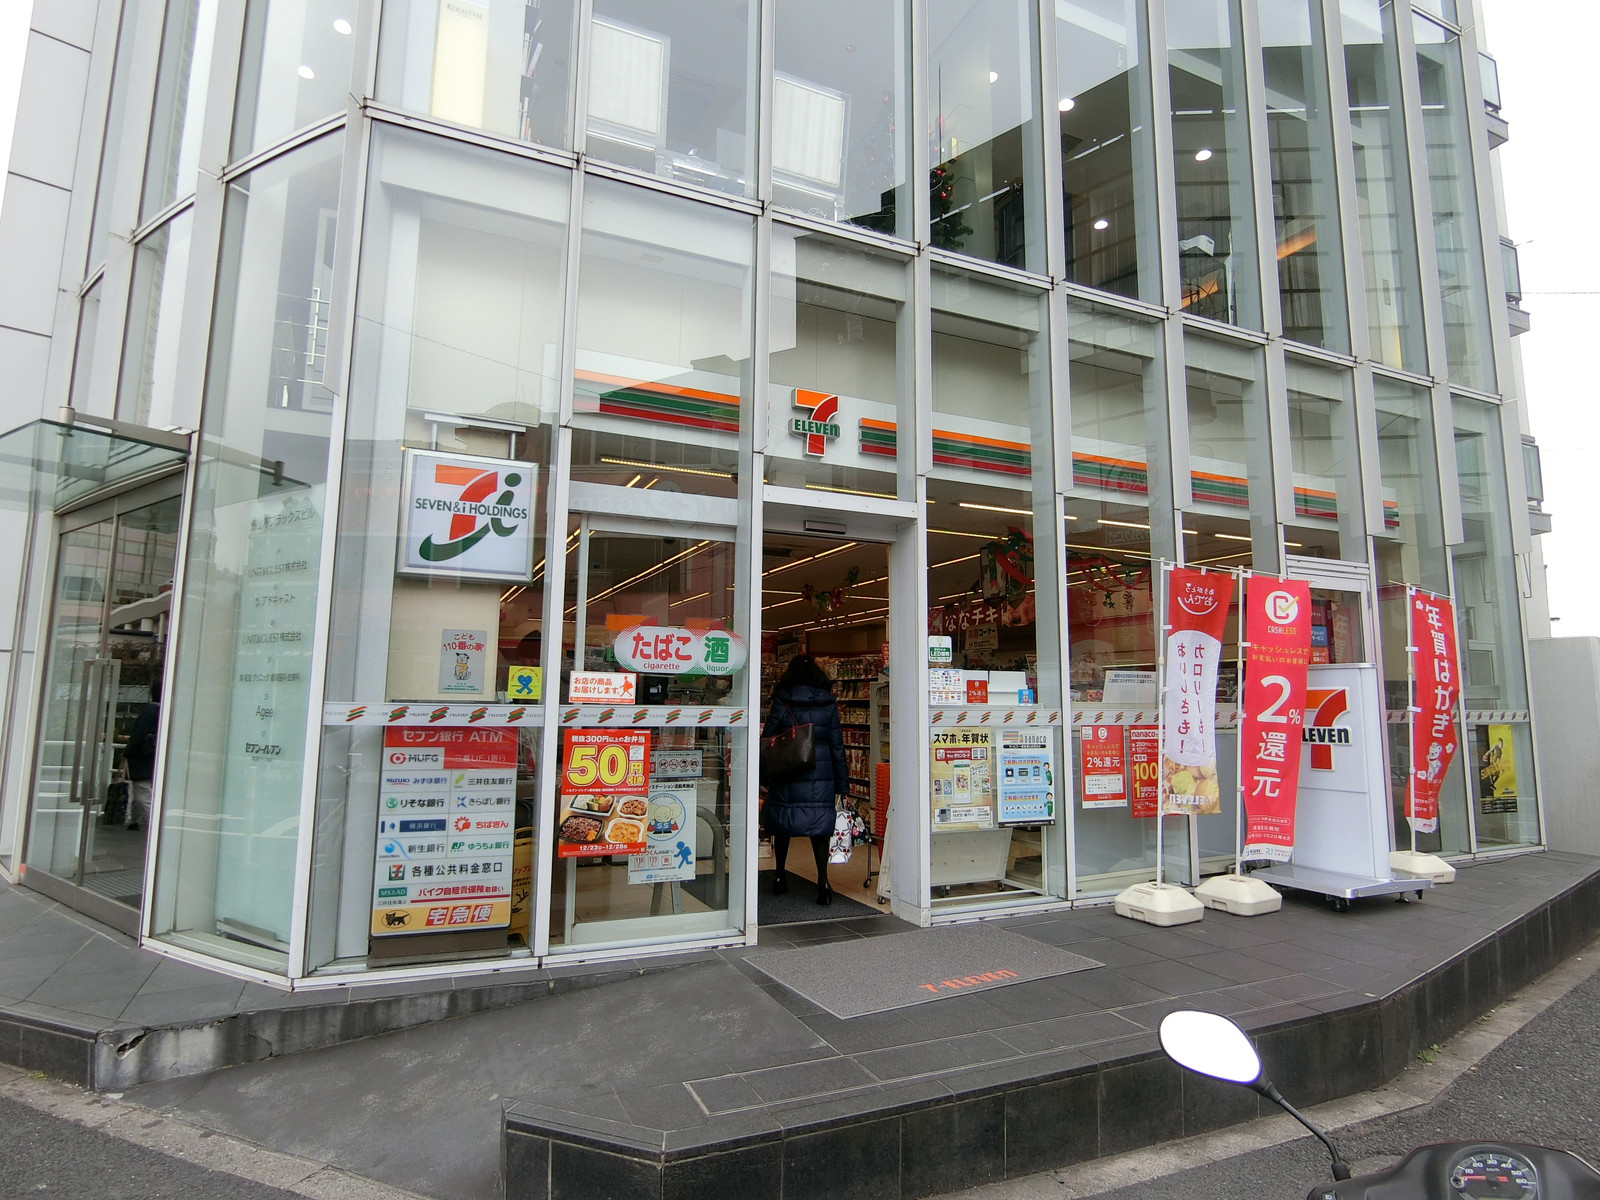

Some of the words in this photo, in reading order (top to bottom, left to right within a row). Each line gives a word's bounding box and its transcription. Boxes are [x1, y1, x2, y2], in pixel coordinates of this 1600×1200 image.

[469, 504, 527, 519] HOLDINGS
[1268, 626, 1297, 635] CASHLESS
[443, 641, 484, 652] 110番の家
[632, 632, 692, 661] たばこ
[704, 636, 729, 663] 酒
[1251, 643, 1309, 655] キャッシュレスで
[1252, 654, 1308, 665] お支払いのお客様に
[643, 661, 680, 672] cigarette
[706, 664, 729, 672] liquor
[1425, 604, 1451, 738] 年賀はがき
[573, 677, 612, 686] お店の商品
[403, 730, 464, 742] セブン銀行
[469, 731, 503, 742] ATM
[571, 735, 645, 743] 税抜300円以上のお弁当
[934, 733, 989, 744] スマホで年賀状
[408, 754, 439, 762] MUFG
[1086, 757, 1120, 768] 2%還元
[412, 777, 448, 785] みずほ銀行
[468, 777, 513, 785] 三井住友銀行
[400, 798, 445, 808] りそな銀行
[469, 797, 511, 806] きらぼし銀行
[475, 821, 509, 829] ちばぎん
[408, 844, 445, 853] 新生銀行
[467, 841, 510, 850] ゆうちょ銀行
[411, 862, 503, 877] 各種公共料金窓口
[427, 905, 492, 924] 宅急便
